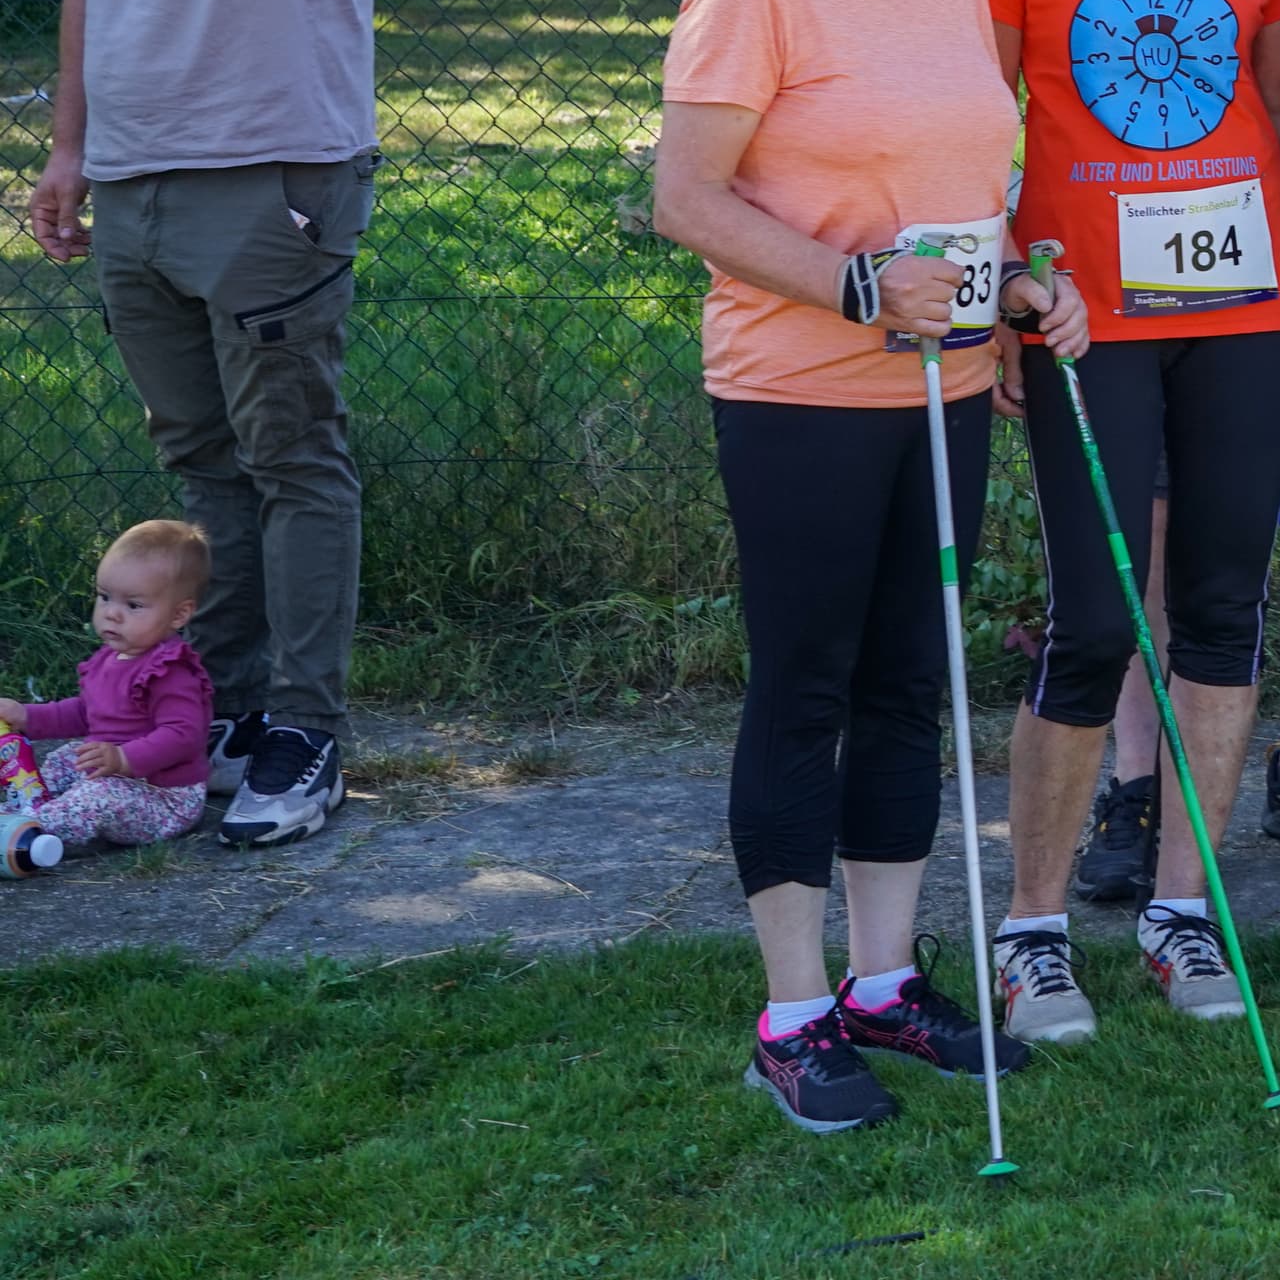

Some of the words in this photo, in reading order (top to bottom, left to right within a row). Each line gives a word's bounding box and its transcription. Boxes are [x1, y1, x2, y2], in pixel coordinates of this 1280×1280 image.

[1094, 20, 1117, 37] 2
[1195, 17, 1219, 42] 10
[1087, 52, 1110, 64] 3
[1141, 47, 1171, 67] HU
[1070, 162, 1116, 183] ALTER
[1120, 162, 1152, 182] UND
[1158, 156, 1258, 182] LAUFLEISTUNG
[1128, 207, 1185, 218] Stellichter
[1164, 225, 1243, 274] 184
[956, 261, 992, 307] 83
